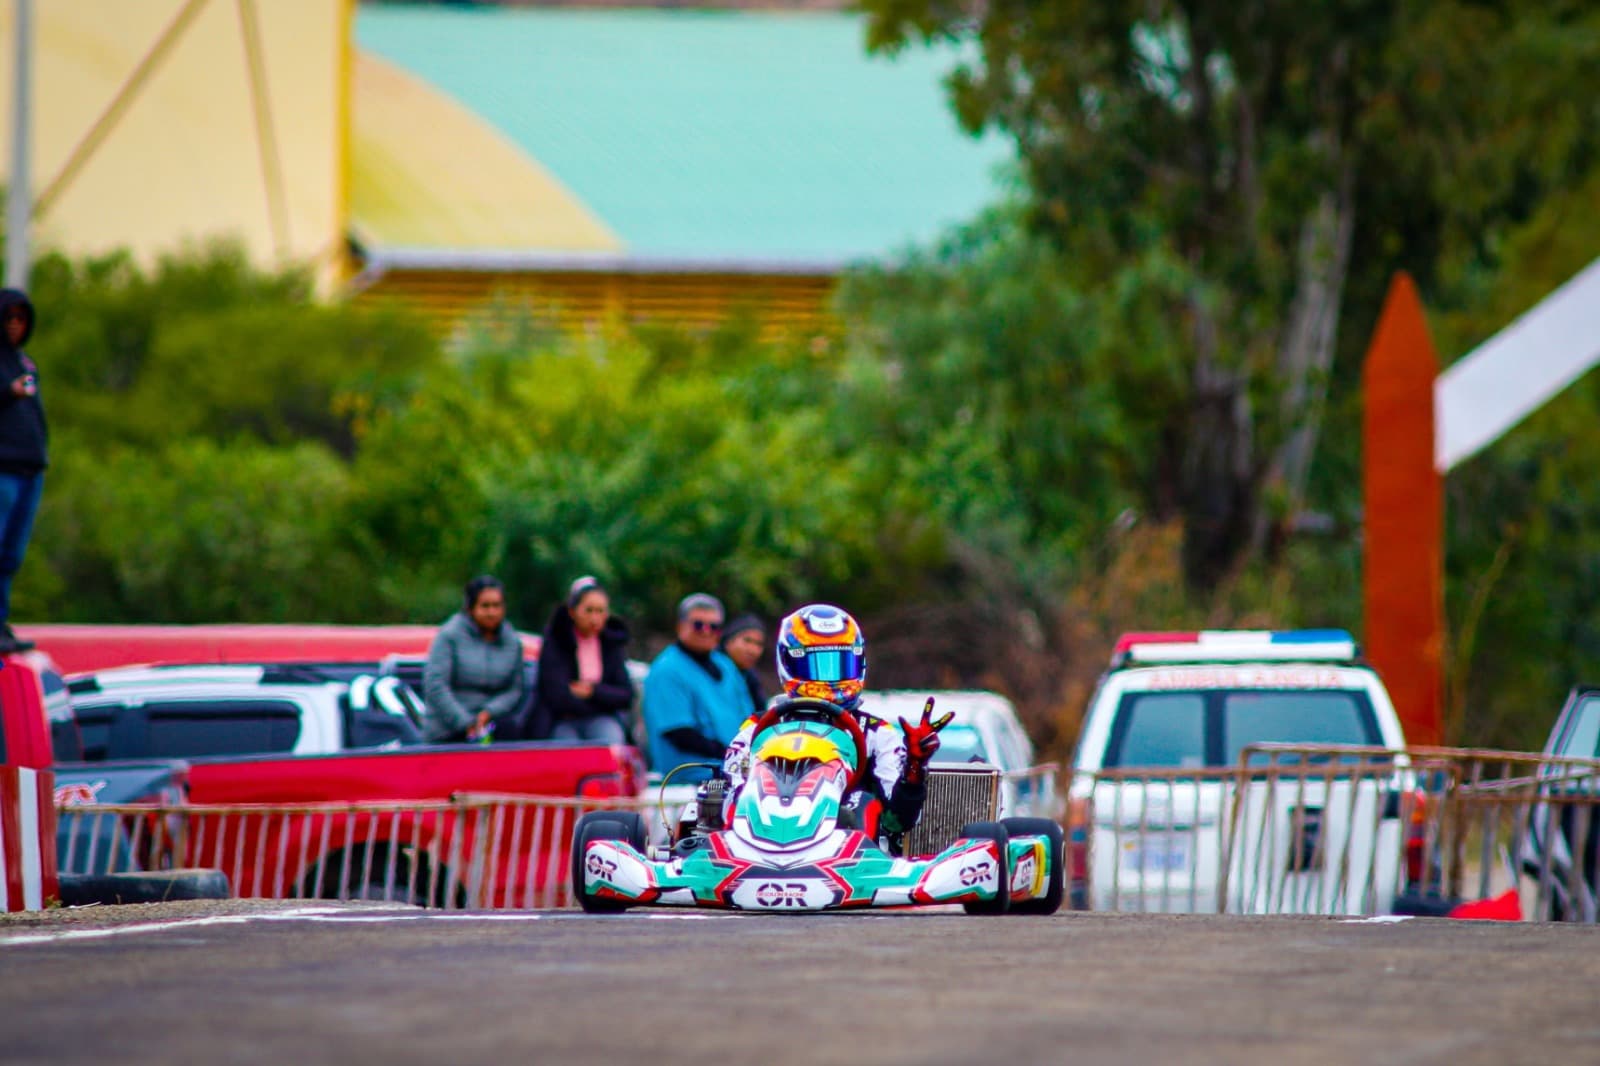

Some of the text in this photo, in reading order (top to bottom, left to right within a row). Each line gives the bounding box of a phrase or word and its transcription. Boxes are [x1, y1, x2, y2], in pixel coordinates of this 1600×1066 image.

[587, 854, 618, 882] OR
[960, 862, 992, 886] OR
[756, 883, 808, 907] OR
